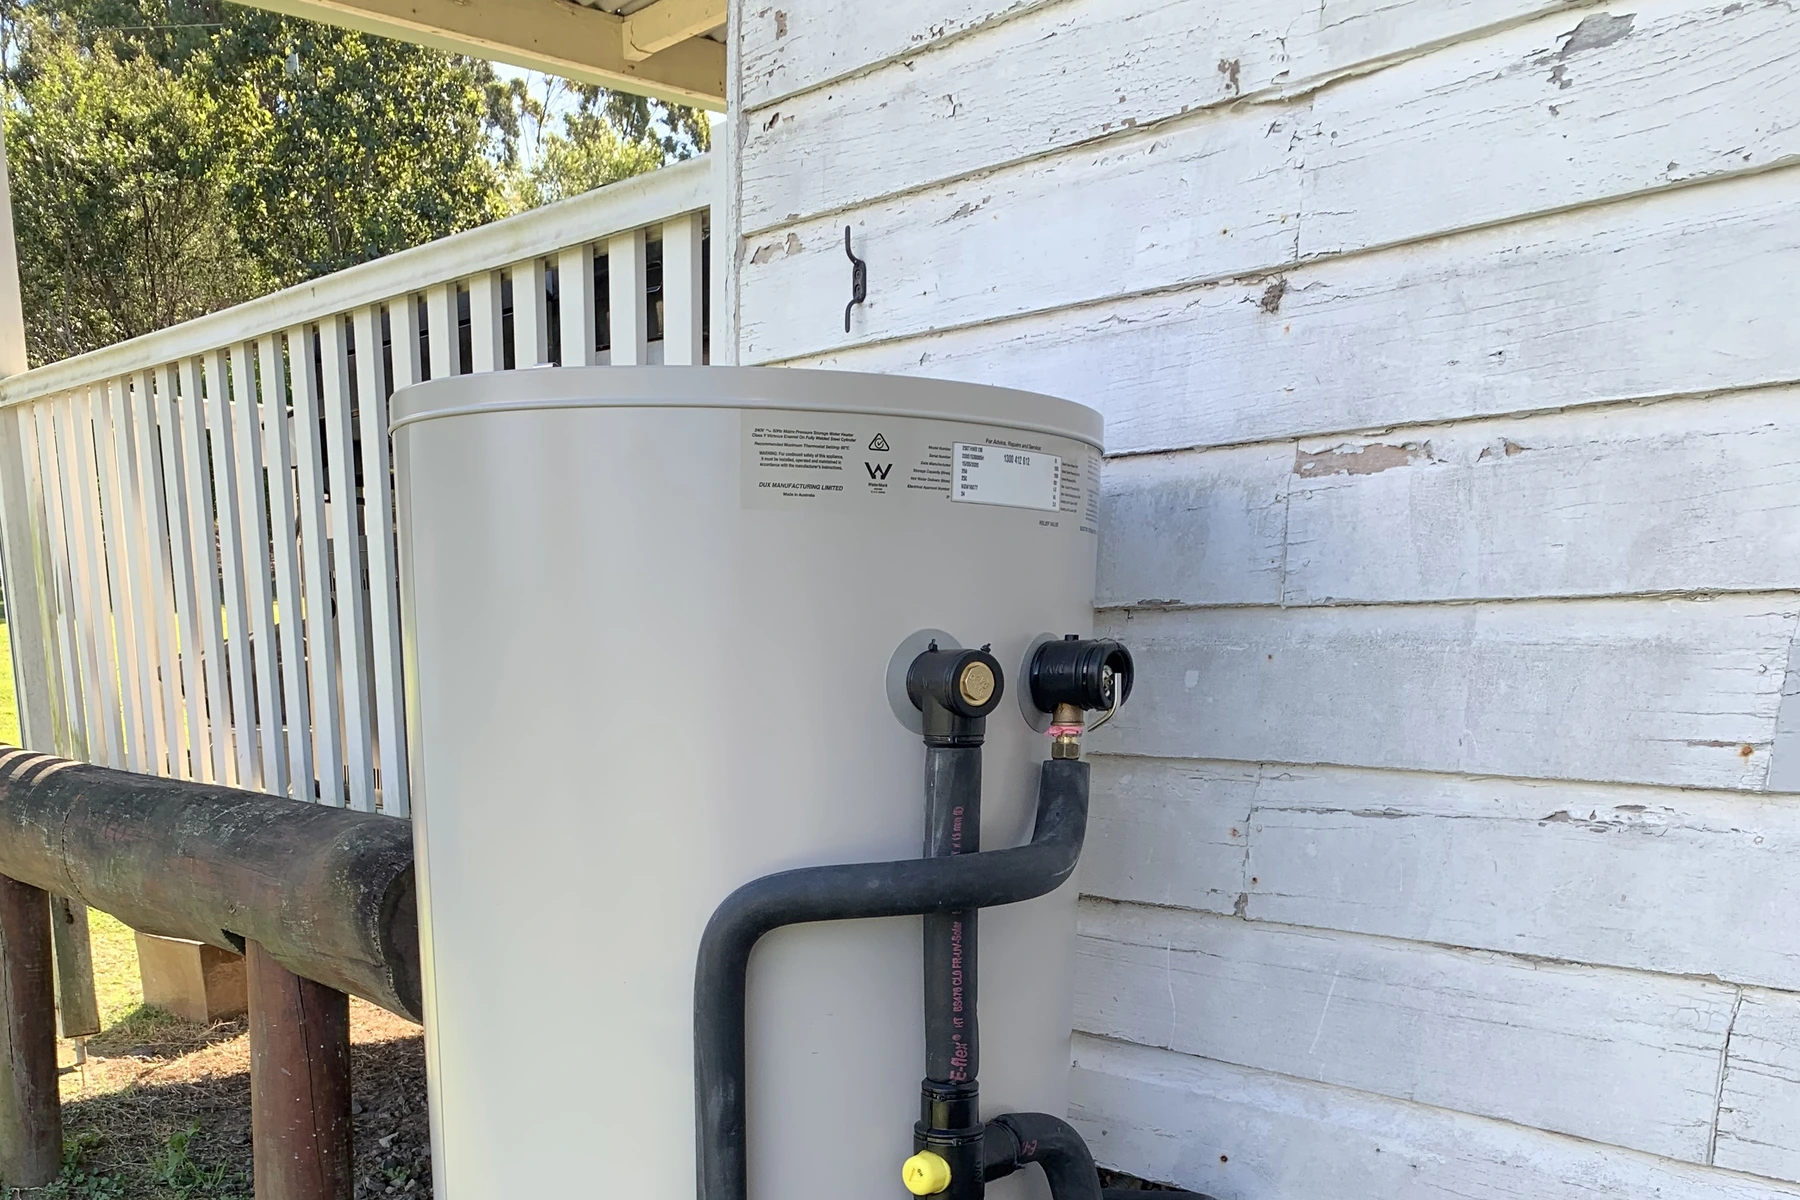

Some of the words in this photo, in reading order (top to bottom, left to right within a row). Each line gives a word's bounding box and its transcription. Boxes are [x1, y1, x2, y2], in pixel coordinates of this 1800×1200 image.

[1004, 454, 1014, 464] 1300
[951, 921, 963, 968] FR-UV-Solar
[953, 1017, 964, 1028] HT
